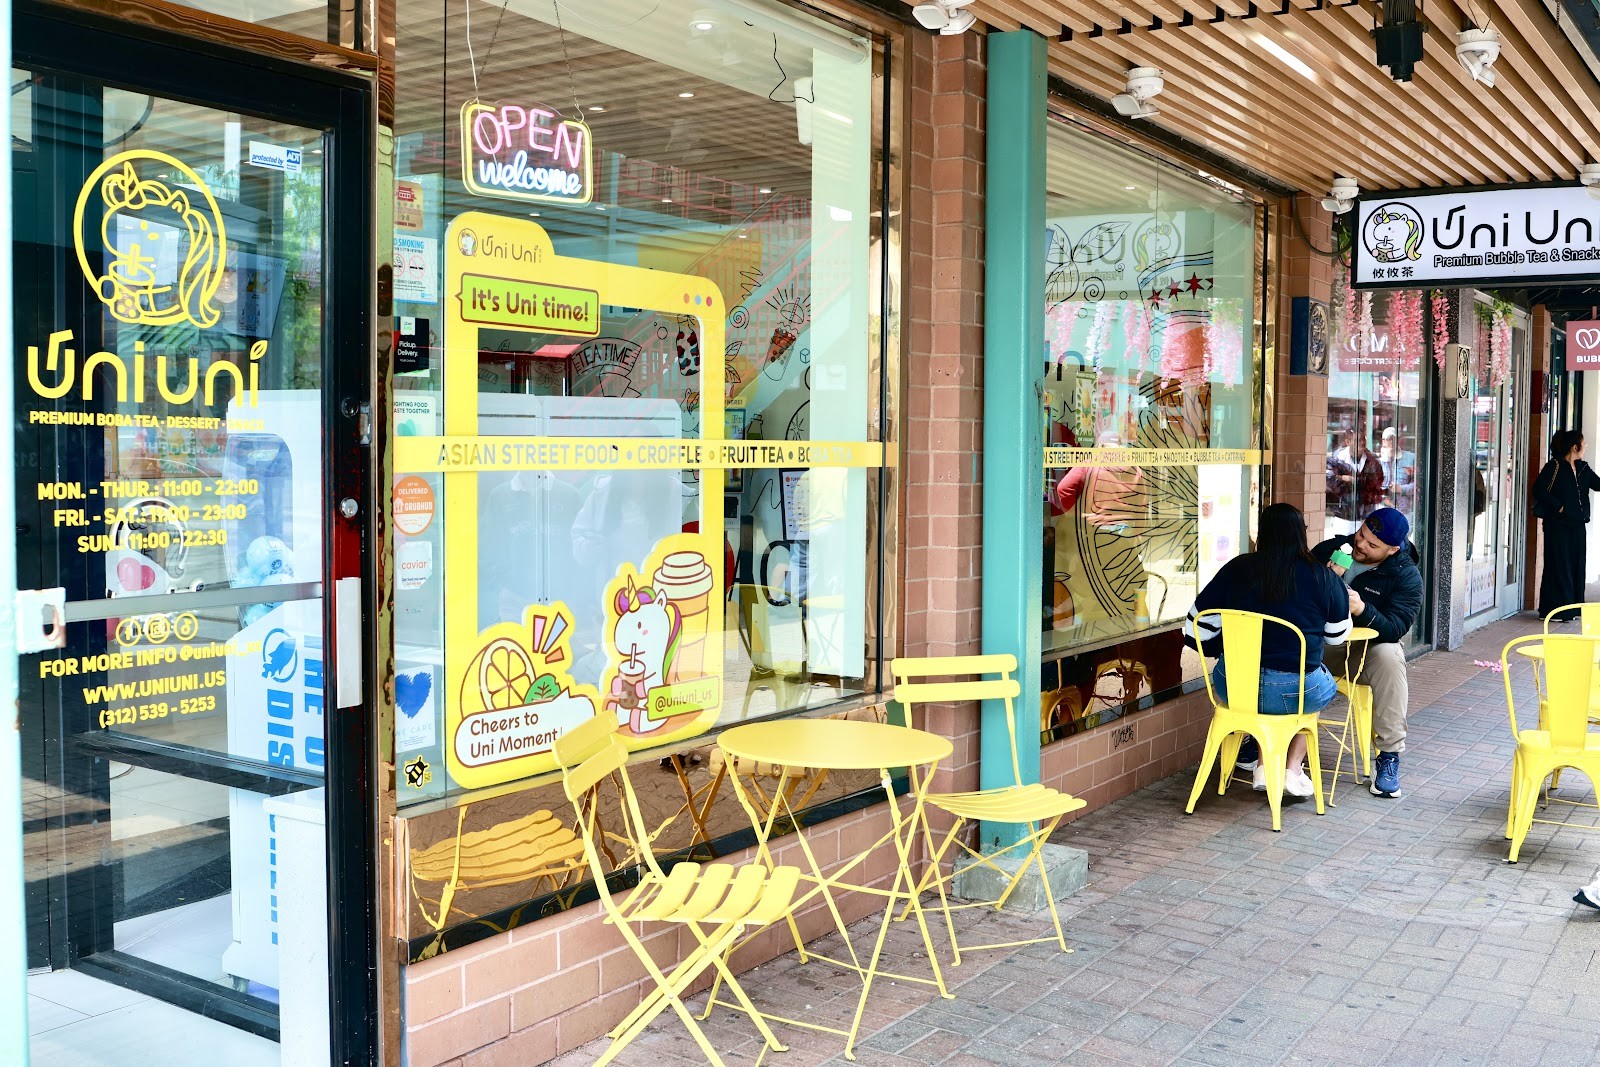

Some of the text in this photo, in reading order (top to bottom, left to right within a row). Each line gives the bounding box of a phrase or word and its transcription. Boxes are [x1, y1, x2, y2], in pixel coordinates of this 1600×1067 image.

[474, 105, 583, 169] OPEN
[287, 150, 300, 164] ADT
[479, 150, 583, 195] welcome
[399, 238, 425, 250] SMOKING
[1433, 254, 1483, 268] Premium
[1484, 252, 1525, 266] Bubble
[1526, 250, 1548, 263] Tea
[1549, 249, 1560, 262] &
[472, 287, 589, 322] It's Uni time!
[577, 342, 633, 370] TEA TIME
[29, 410, 95, 426] PREMIUM
[96, 412, 135, 428] BOBA
[135, 414, 159, 428] TEA
[166, 415, 221, 430] DESSERT
[437, 444, 496, 465] ASIAN
[501, 443, 571, 465] STREET
[575, 444, 620, 465] FOOD
[637, 444, 703, 464] CROFFLE
[719, 445, 758, 464] FRUIT
[762, 446, 785, 464] TEA
[1049, 451, 1075, 464] STREET
[1075, 451, 1093, 464] FOOD
[1131, 451, 1148, 463] FRUIT
[1148, 451, 1158, 463] TEA
[38, 482, 86, 500] MON.
[162, 480, 201, 497] 11:00
[215, 479, 258, 495] 22:00
[54, 509, 90, 527] FRI.
[150, 506, 189, 523] 11:00
[202, 504, 246, 521] 23:00
[404, 501, 432, 511] GRUBHUB
[128, 532, 170, 550] 11:00
[183, 529, 227, 547] 22:30
[401, 560, 427, 570] caviar
[40, 640, 262, 679] FOR MORE INFO @uniuni_us
[82, 670, 227, 705] WWW.UNIUNI.US
[98, 705, 138, 729] (312)
[139, 702, 168, 721] 539
[180, 695, 216, 714] 5253
[655, 691, 713, 713] @uniuni_us
[470, 712, 539, 737] Cheers to
[470, 740, 495, 759] Uni
